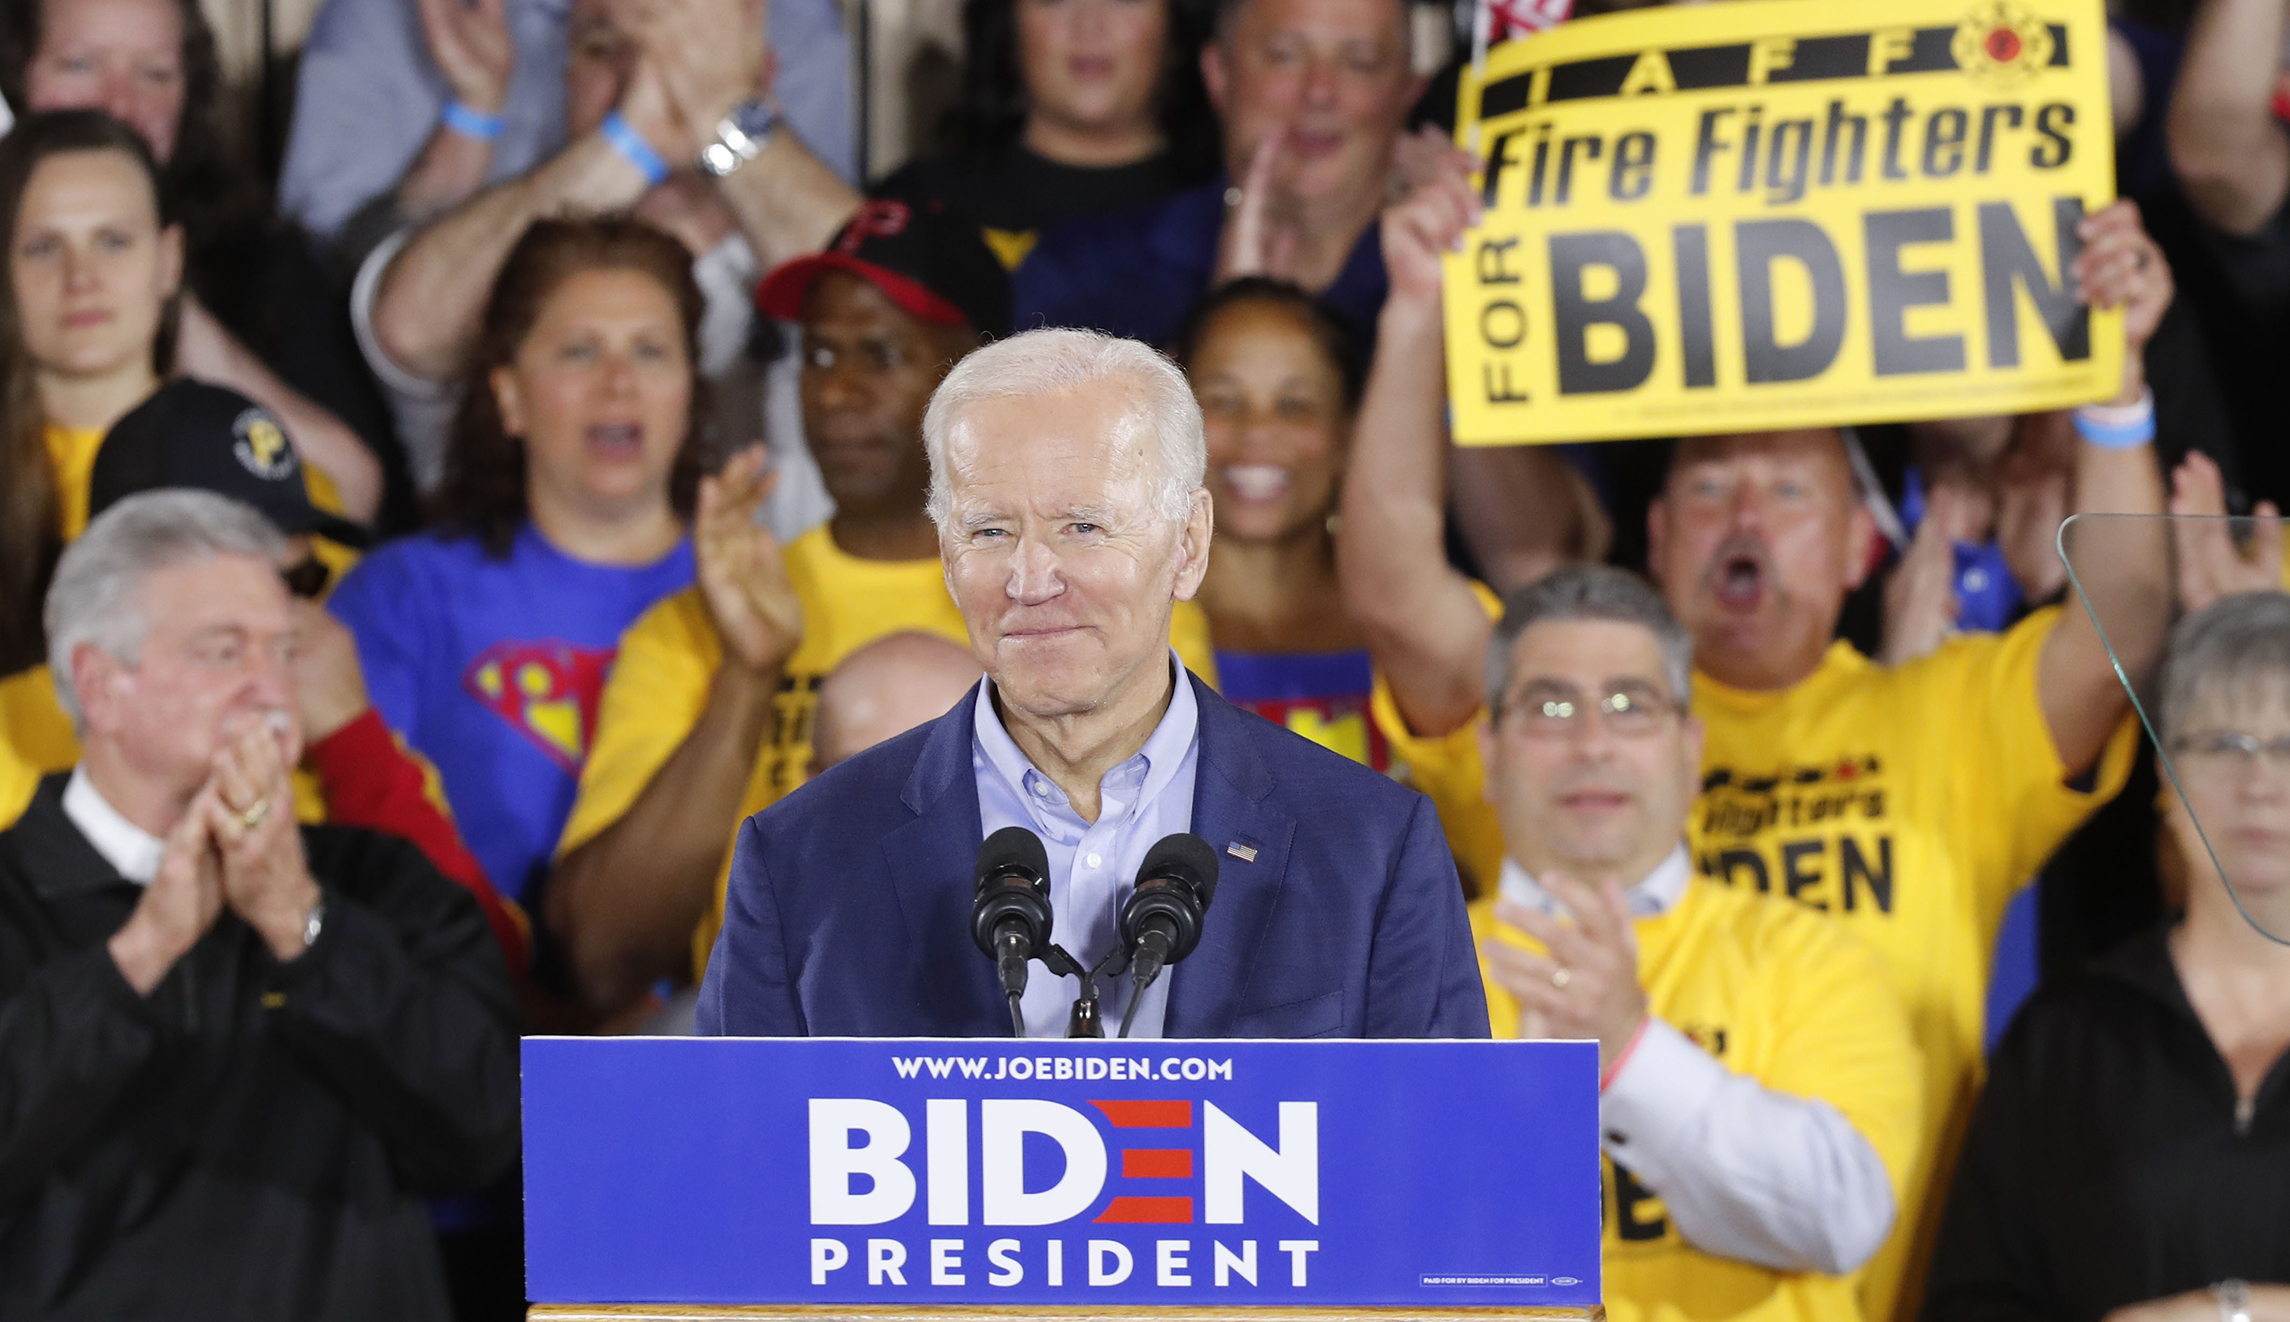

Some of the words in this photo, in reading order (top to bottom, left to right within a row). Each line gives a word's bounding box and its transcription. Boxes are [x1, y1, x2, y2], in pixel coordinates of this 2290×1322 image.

[1484, 122, 1656, 208] Fire
[1690, 99, 2077, 206] Fighters
[1478, 236, 1528, 404] FOR
[1547, 197, 2093, 396] BIDEN
[1701, 837, 1892, 913] DEN
[892, 1057, 1234, 1081] WWW.JOEBIDEN.COM
[809, 1099, 1319, 1226] BIDEN
[811, 1239, 1319, 1287] PRESIDENT
[1423, 1277, 1440, 1285] PAID
[1441, 1277, 1456, 1285] FOR
[1457, 1277, 1467, 1285] BY
[1467, 1277, 1489, 1285] BIDEN
[1490, 1277, 1504, 1285] FOR
[1505, 1277, 1544, 1285] PRESIDENT
